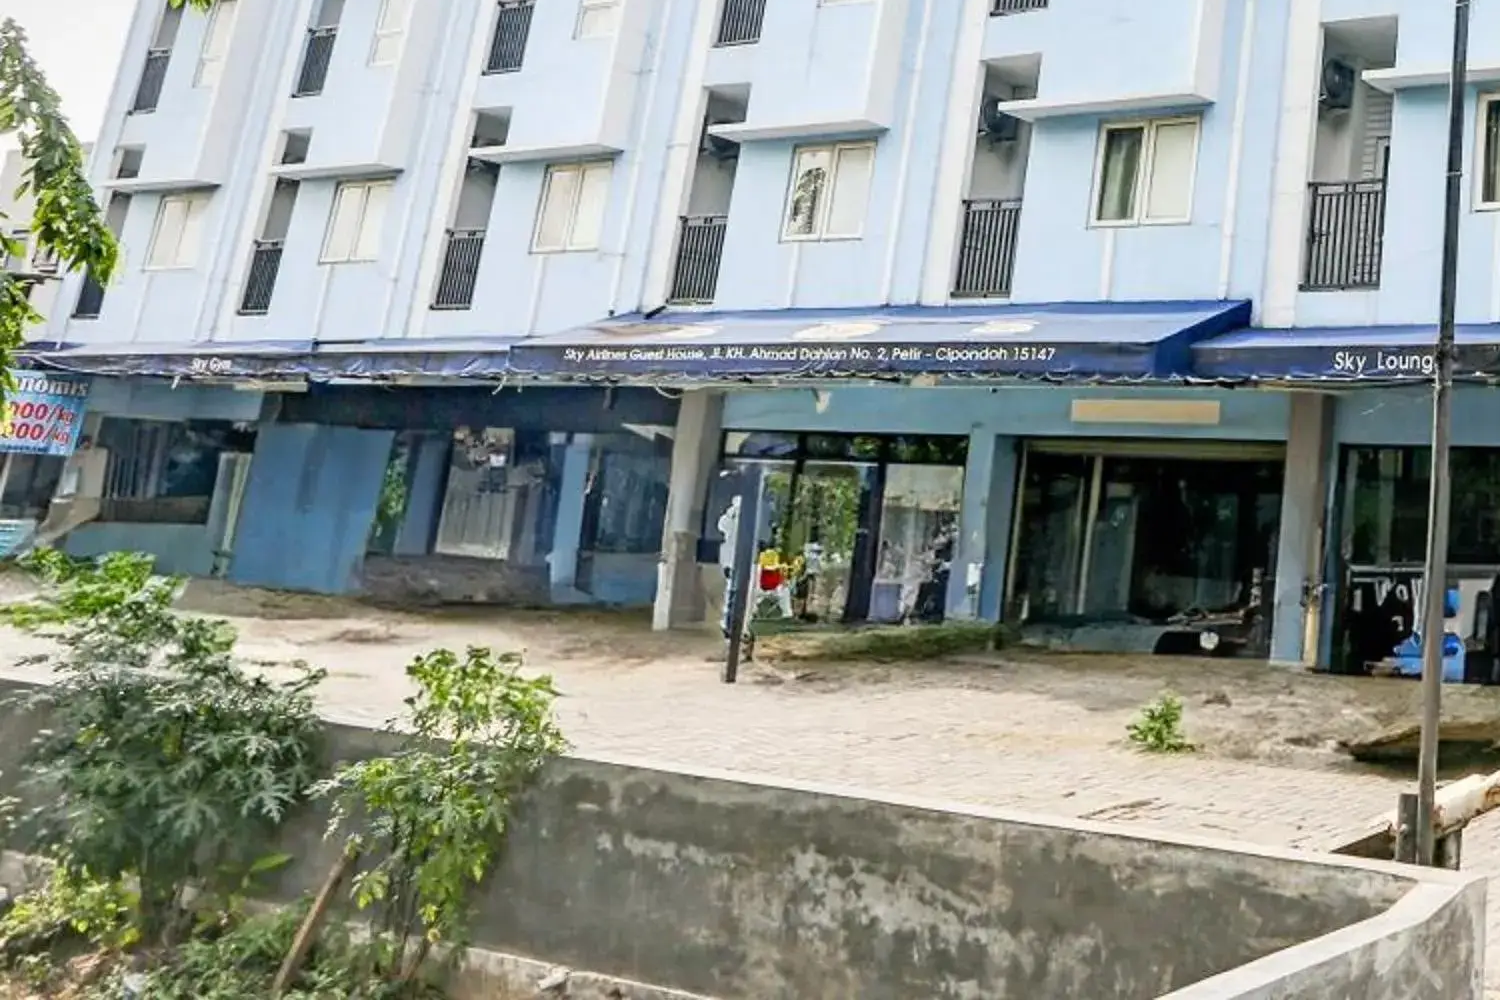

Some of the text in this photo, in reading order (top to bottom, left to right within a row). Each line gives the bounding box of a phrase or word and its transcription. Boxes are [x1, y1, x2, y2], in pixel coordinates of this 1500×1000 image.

[563, 348, 583, 362] Sky
[750, 347, 797, 361] Ahmad
[850, 348, 873, 359] No.
[935, 347, 1007, 363] Cipondoh
[1014, 348, 1056, 361] 15147
[1334, 351, 1434, 374] Sky Loung
